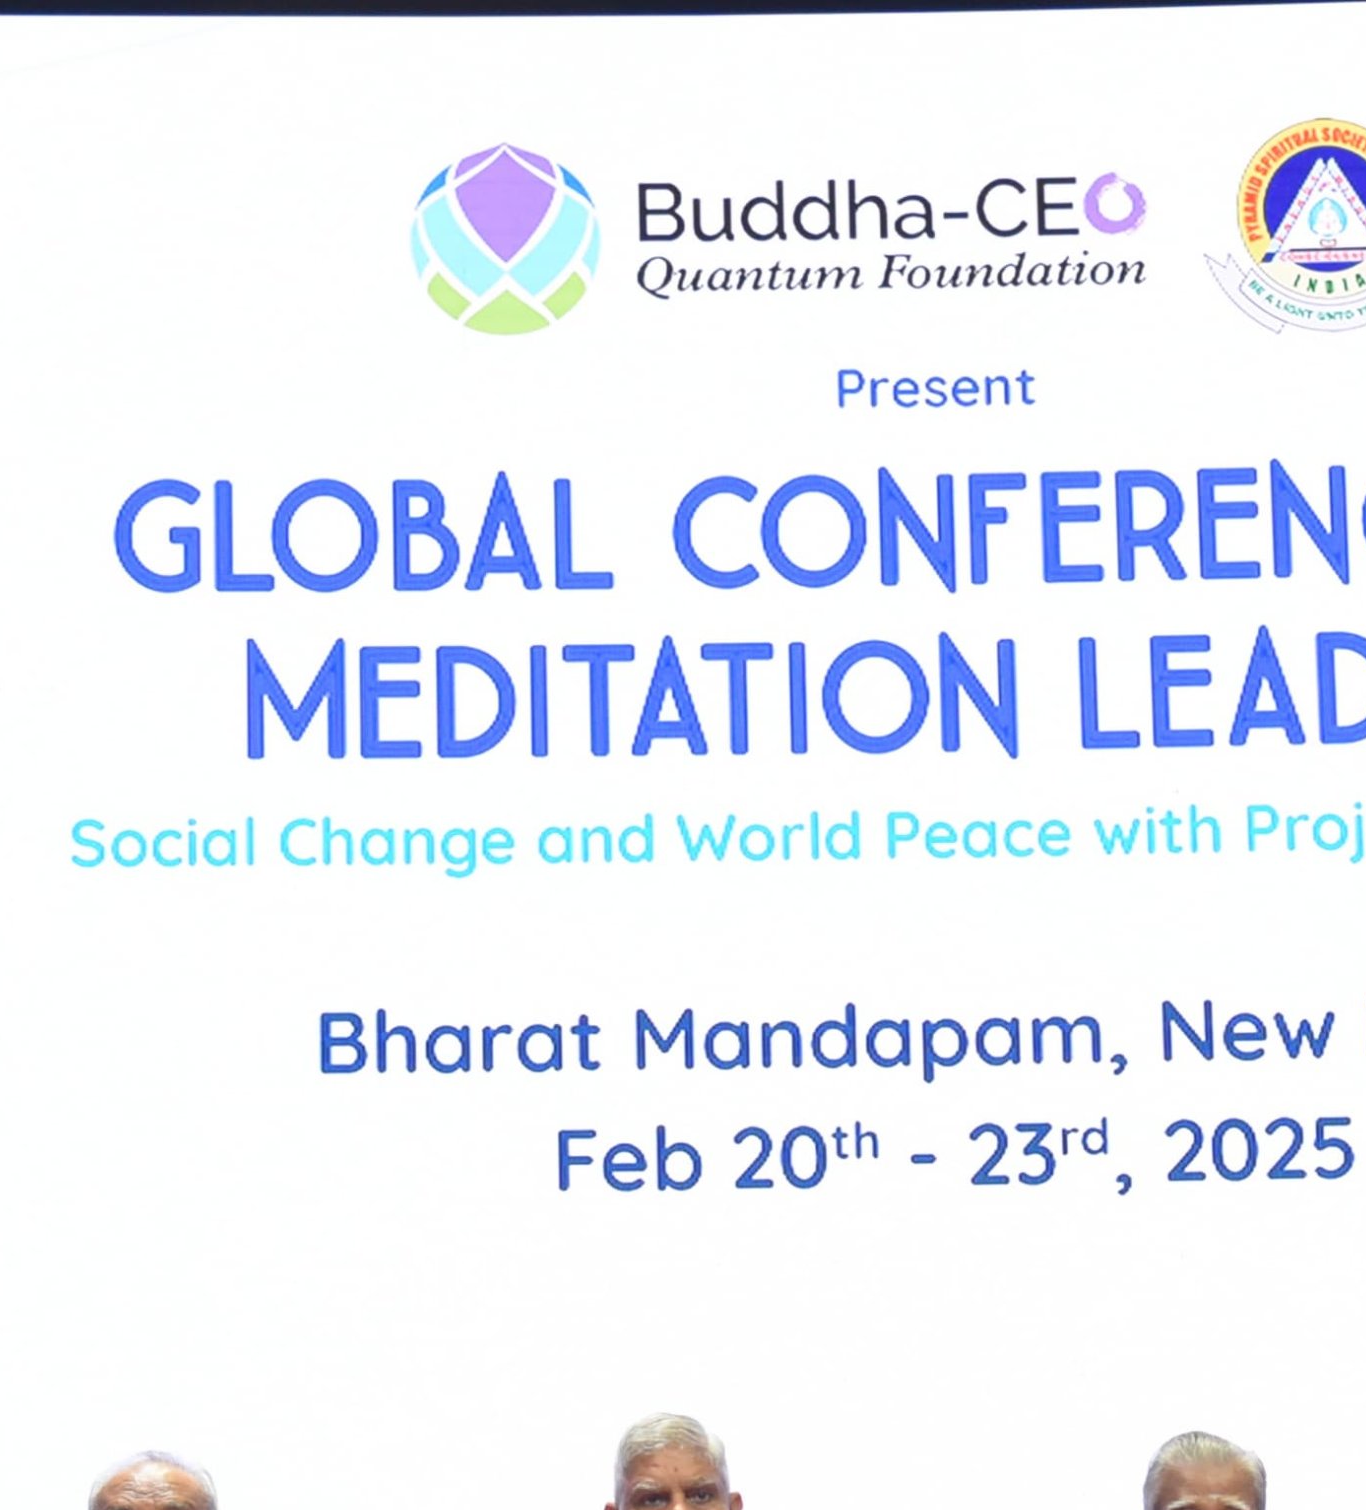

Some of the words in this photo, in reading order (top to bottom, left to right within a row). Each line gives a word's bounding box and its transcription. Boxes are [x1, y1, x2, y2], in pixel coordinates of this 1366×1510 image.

[1244, 176, 1263, 242] PYRAMID
[1255, 128, 1319, 176] SPIRITUAL
[637, 254, 862, 300] Quantum
[878, 248, 1147, 291] Foundation
[1294, 273, 1366, 294] INDIA
[836, 367, 1036, 410] Present
[113, 470, 615, 594] GLOBAL
[246, 630, 1020, 761] MEDITATION
[70, 815, 256, 869] Social
[279, 814, 516, 880] Change
[537, 812, 655, 865] and
[675, 810, 862, 862] World
[886, 810, 1072, 860] Peace
[1093, 803, 1223, 856] with
[319, 1006, 601, 1075] Bharat
[635, 1001, 1129, 1085] Mandapam,
[1161, 999, 1336, 1063] New
[557, 1124, 703, 1193] Feb
[1164, 1116, 1356, 1182] 2025
